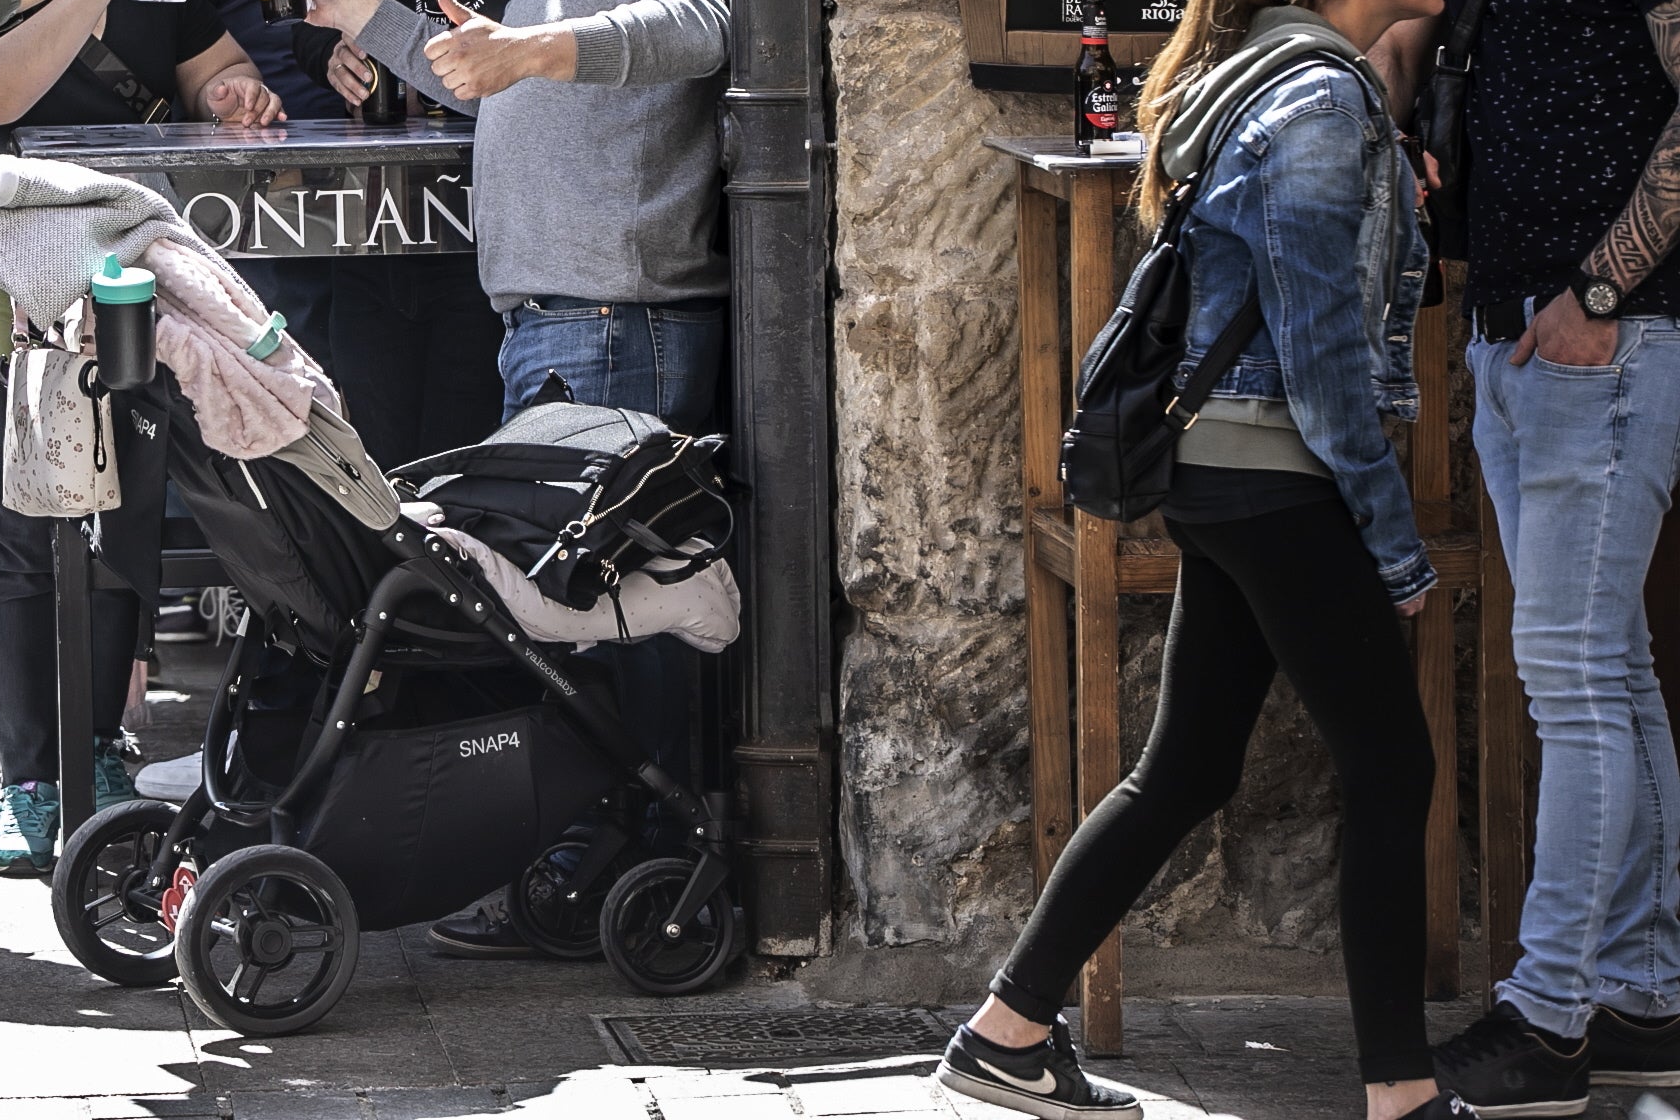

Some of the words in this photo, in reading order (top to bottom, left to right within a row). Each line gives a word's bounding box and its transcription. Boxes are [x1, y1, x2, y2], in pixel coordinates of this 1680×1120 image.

[182, 174, 476, 251] ONTAÑ
[525, 647, 577, 696] valcobaby
[460, 731, 520, 758] SNAP4
